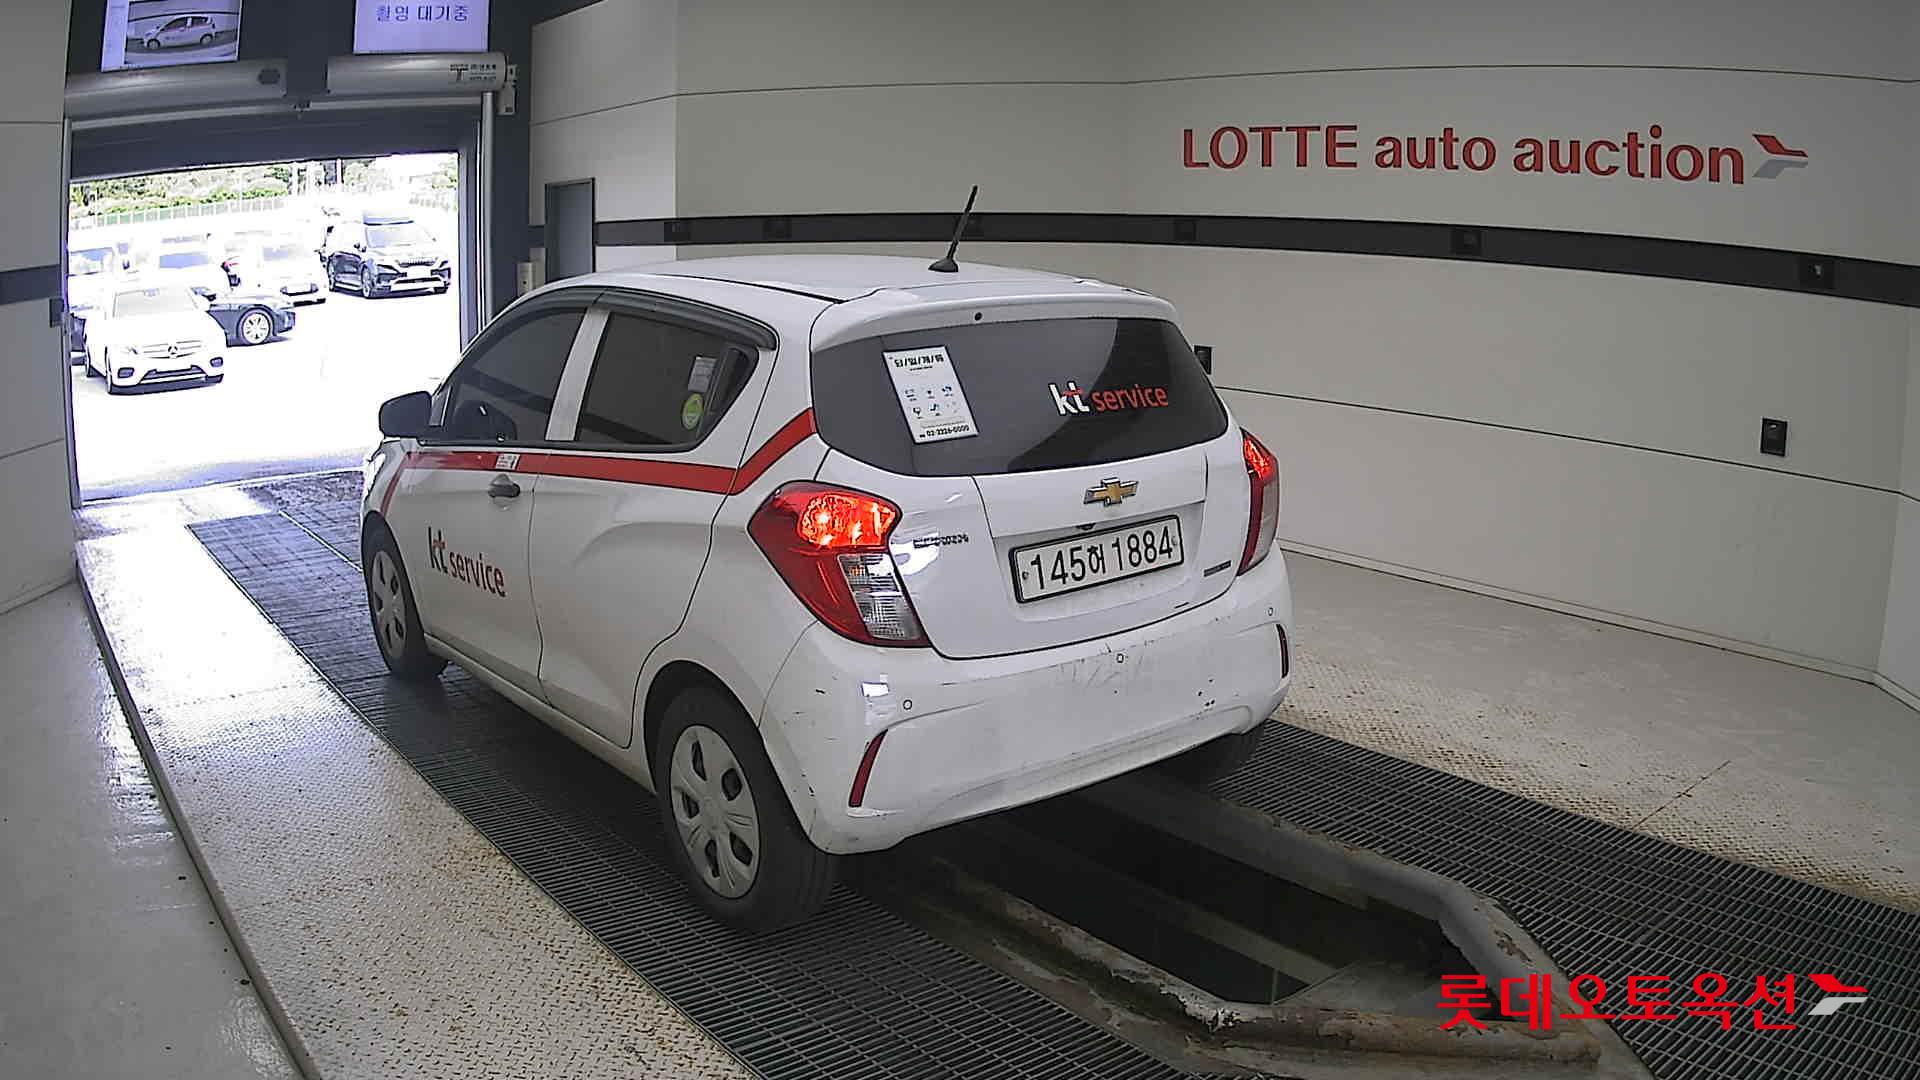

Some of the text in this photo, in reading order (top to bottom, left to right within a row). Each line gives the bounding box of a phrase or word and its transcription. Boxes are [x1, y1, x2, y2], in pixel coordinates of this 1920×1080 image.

[417, 4, 469, 22] 대기중
[1183, 124, 1744, 185] LOTTE auto auction
[1048, 381, 1169, 416] kt service
[428, 526, 506, 597] kt service
[1111, 526, 1173, 571] 1884
